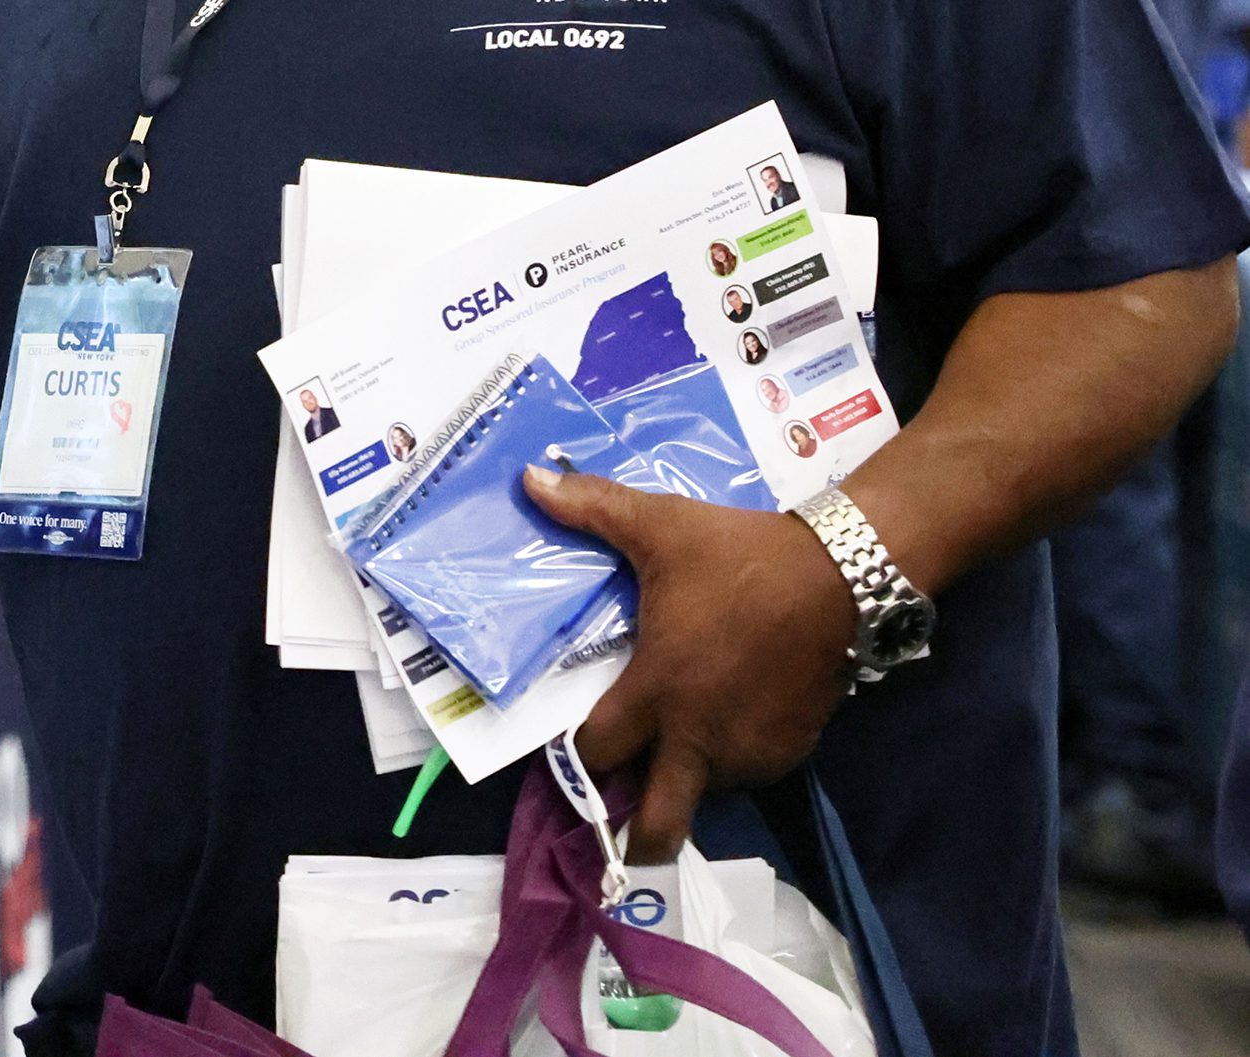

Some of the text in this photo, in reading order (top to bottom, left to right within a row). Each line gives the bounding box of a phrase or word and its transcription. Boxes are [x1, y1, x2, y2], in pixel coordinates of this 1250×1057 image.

[484, 27, 625, 50] LOCAL 0692
[551, 242, 591, 265] PEARL
[555, 237, 627, 275] INSURANCE
[441, 281, 515, 332] CSEA
[57, 321, 116, 352] CSEA
[44, 370, 122, 397] CURTIS
[19, 512, 43, 525] voice
[44, 513, 59, 527] for
[60, 517, 87, 533] many.
